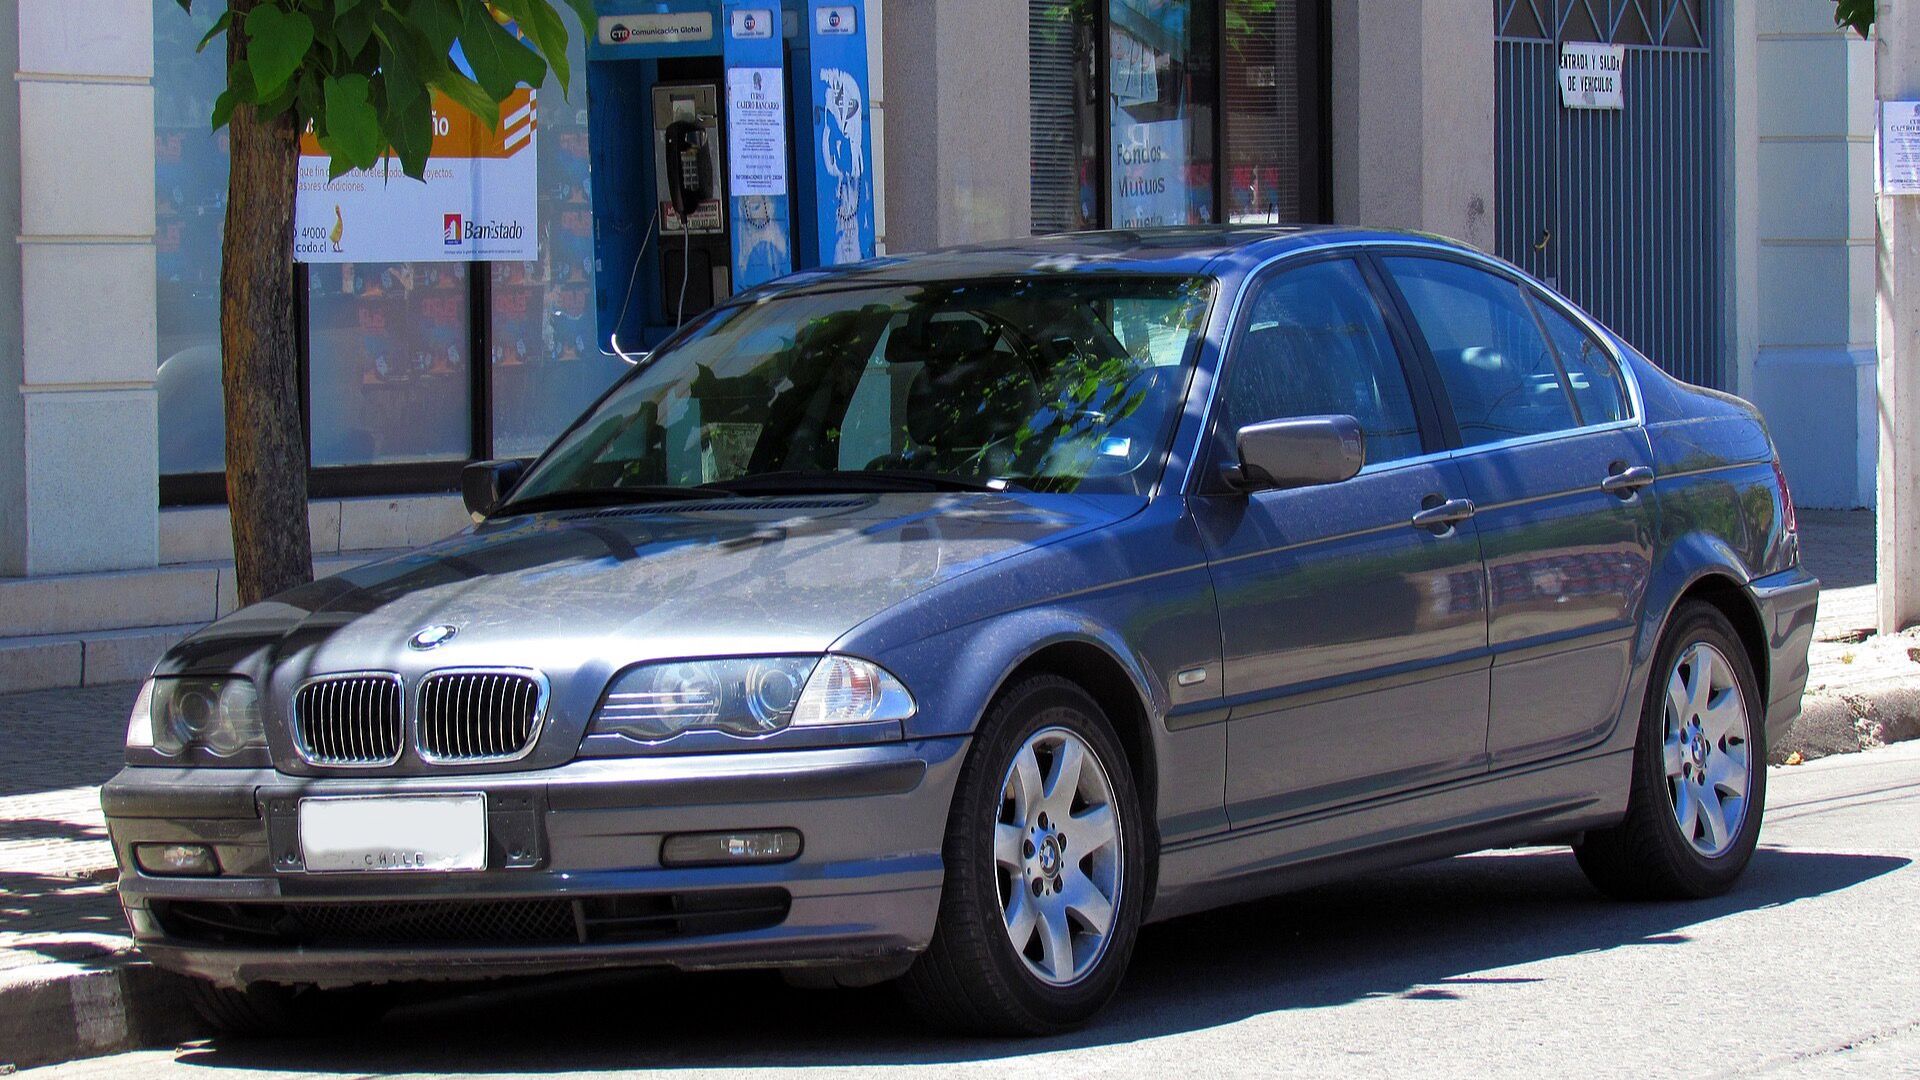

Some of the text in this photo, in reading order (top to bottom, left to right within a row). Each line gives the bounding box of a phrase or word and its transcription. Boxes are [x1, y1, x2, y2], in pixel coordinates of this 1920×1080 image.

[631, 26, 679, 36] Comunicación
[680, 25, 702, 33] Global
[1560, 54, 1620, 71] ENTRADA Y SALIDA
[1567, 75, 1576, 91] DE
[1117, 140, 1162, 166] Fondos
[1119, 176, 1166, 198] Mutuos
[364, 852, 425, 866] CHILE
